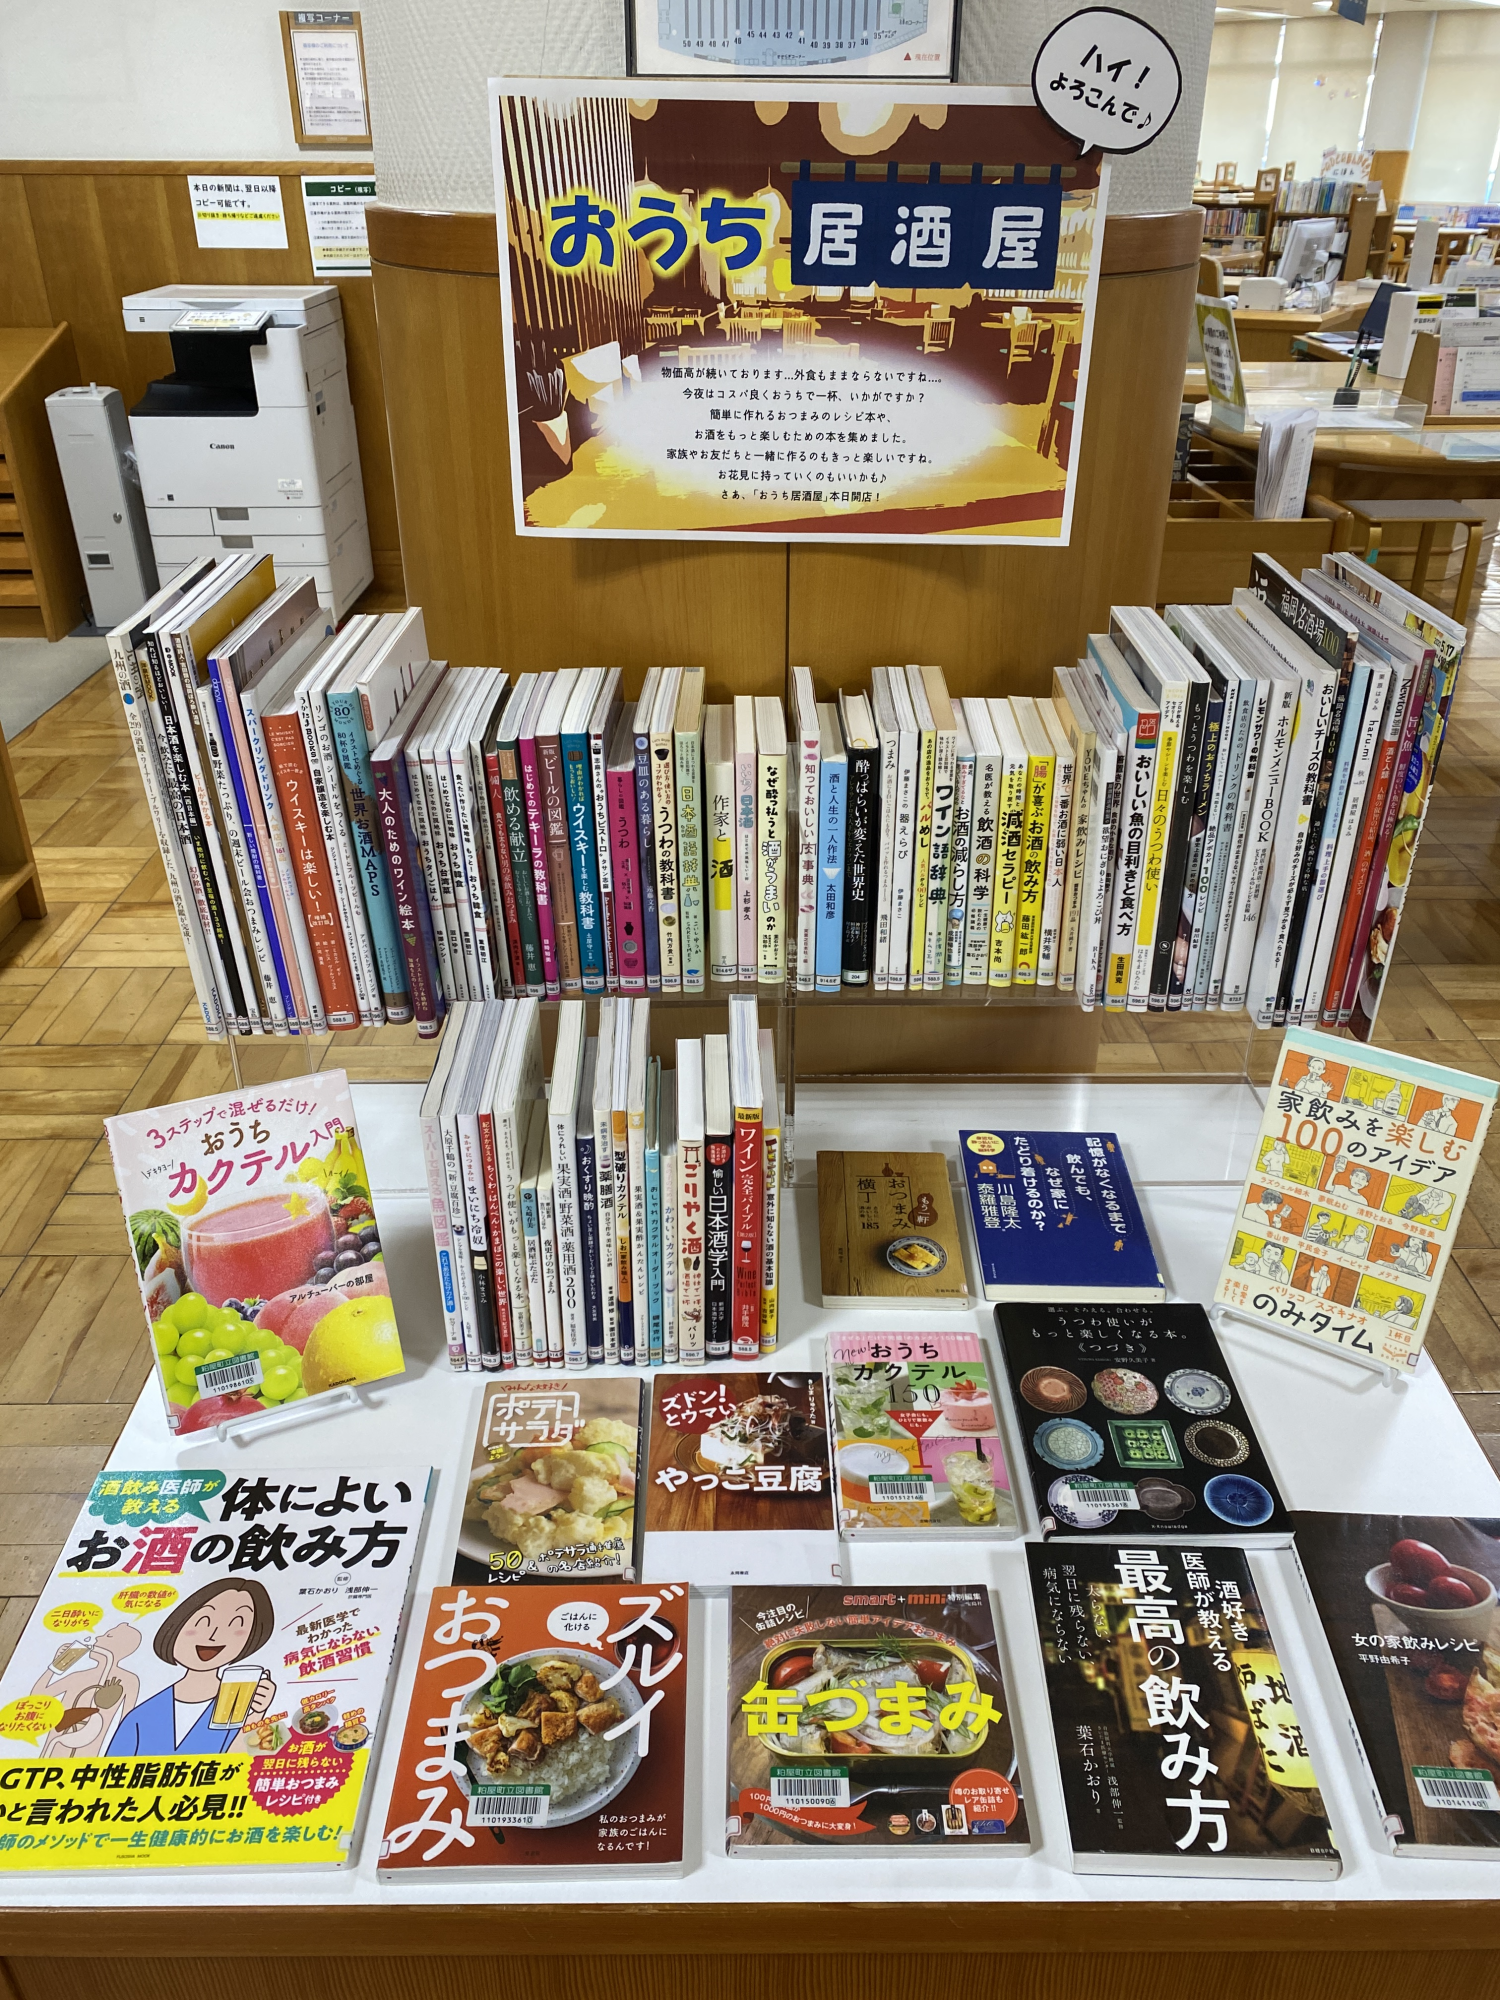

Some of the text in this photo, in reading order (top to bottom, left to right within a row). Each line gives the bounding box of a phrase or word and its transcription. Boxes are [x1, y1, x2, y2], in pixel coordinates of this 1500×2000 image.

[298, 13, 349, 23] 複写コーナー
[683, 40, 729, 48] 50 49 48 47
[734, 37, 742, 45] 46
[747, 30, 793, 39] 45 44 43 42
[823, 41, 831, 49] 39
[835, 41, 843, 49] 38
[861, 38, 868, 46] 36
[914, 53, 940, 61] 現在位置
[1080, 44, 1150, 89] ハイ！
[194, 183, 276, 193] 本日の新聞は、翌日以降
[196, 200, 251, 208] コピー可能です。
[549, 194, 1045, 271] おうち 居酒屋
[682, 388, 924, 403] 今夜はコスパ良くおうちで一杯、いかがですか？
[710, 408, 891, 423] 簡単に作れるおつまみのレシピ本や、
[694, 429, 907, 443] お酒をもっと楽しむための本を集めました。
[666, 448, 933, 464] 家族やお友だちと一緒に作るのもきっと楽しいですね。
[721, 489, 880, 502] さあ、「おうち居酒屋」本日開店！
[1281, 589, 1340, 656] 福岡名酒場100
[113, 648, 133, 691] 九州の酒
[884, 739, 897, 769] つまみ
[1180, 703, 1201, 804] もっとうつわを楽しむ
[1246, 699, 1265, 779] レモンサワーの教科書
[1302, 683, 1333, 806] おいしいチーズの教科書
[246, 708, 274, 810] スパークリングドリンク
[1197, 721, 1219, 817] 極上のおうちラーメン
[544, 758, 565, 836] ビールの図鑑
[636, 754, 651, 849] 豆皿のある暮らし
[1222, 753, 1243, 833] ドリンクの教科書
[504, 786, 527, 863] 飲める献立
[618, 817, 629, 849] うつわ
[826, 774, 840, 864] 酒と人生の一人作法
[852, 759, 870, 901] 酔っぱらいが変えた世界史
[919, 802, 932, 848] バルめし
[1022, 761, 1049, 903] 「腸」が喜ぶお酒の飲み方
[285, 779, 323, 913] ウイスキーは楽しい！
[525, 765, 548, 906] はじめてのテキーラの教科書
[711, 795, 734, 879] 作家と酒
[929, 785, 954, 905] ワイン語辞典
[1117, 754, 1151, 936] おいしい魚の目利きと食べ方
[1145, 790, 1168, 891] 日々のうつわ使い
[379, 789, 415, 930] 大人のためのワイン絵本
[572, 803, 595, 930] ウイスキーを楽しむ教科書
[658, 807, 675, 900] うつわの教科書
[949, 807, 970, 907] お酒の減らし方
[973, 817, 993, 900] 飲酒の科学
[1001, 811, 1023, 905] 減酒セラピー
[825, 884, 836, 920] 太田和彦
[201, 1120, 271, 1155] おうち
[1277, 1091, 1468, 1162] 家飲みを楽しむ
[1278, 1113, 1457, 1184] 100のアイデア
[582, 1156, 594, 1210] おくすり晩酌
[600, 1171, 614, 1208] 薬膳酒
[740, 1128, 759, 1230] ワイン完全バイブル
[857, 1178, 877, 1204] 横丁
[1014, 1136, 1046, 1231] たどり着けるのか？
[1046, 1167, 1069, 1210] なぜ家に
[1066, 1153, 1094, 1203] 飲んでも、
[1086, 1137, 1127, 1233] 記憶がなくなるまで
[467, 1186, 484, 1245] まいにち冷奴
[682, 1163, 702, 1254] ごりやく酒
[888, 1178, 912, 1230] おつまみ
[997, 1183, 1021, 1229] 川島隆太
[1356, 1208, 1393, 1226] 清野とおる
[707, 1168, 729, 1291] 愉しい日本酒学入門
[289, 1273, 374, 1303] アルチューバーの部屋
[1032, 1329, 1188, 1339] もっと楽しくなる本。
[1057, 1316, 1152, 1327] うつわ使いが
[1253, 1293, 1374, 1354] のみタイム
[871, 1343, 939, 1359] おうち
[854, 1364, 966, 1382] カクテル
[496, 1398, 575, 1420] ポテト
[662, 1384, 727, 1412] ズドン！
[886, 1384, 941, 1403] 150
[665, 1400, 736, 1428] とウマい
[493, 1420, 586, 1442] サラダ
[99, 1480, 219, 1495] 酒飲み医師が
[655, 1465, 822, 1493] やっこ豆腐
[122, 1498, 179, 1514] 教える
[220, 1476, 412, 1522] 体によい
[66, 1522, 408, 1574] お酒の飲み方
[489, 1550, 523, 1570] 50
[548, 1553, 621, 1574] の名店紹介！
[487, 1571, 525, 1584] レシピ
[118, 1588, 177, 1601] 肝臓の数値が
[124, 1597, 162, 1608] 気になる
[843, 1594, 946, 1606] smart mini
[1214, 1579, 1249, 1642] 酒好き
[51, 1609, 99, 1619] 二日酔いに
[52, 1618, 90, 1627] なりがち
[296, 1608, 360, 1636] 最新医学で
[561, 1613, 597, 1621] ごはんに
[564, 1623, 590, 1631] 化ける
[755, 1610, 804, 1631] 缶詰レシピ
[756, 1604, 796, 1621] 今注目の
[1042, 1567, 1072, 1663] 病気にならない
[1180, 1551, 1233, 1672] 医師が教える
[284, 1626, 381, 1666] 病気にならない
[308, 1623, 353, 1643] わかった
[763, 1615, 956, 1649] 絶対に失敗しない簡単アイデアおつまみ
[1352, 1633, 1480, 1652] 女の家飲みレシピ
[298, 1641, 374, 1677] 飲酒習慣
[599, 1585, 685, 1757] ズルイ
[14, 1711, 43, 1720] お腹に
[741, 1680, 1002, 1738] 缶づまみ
[1113, 1548, 1231, 1852] 最高の飲み方
[386, 1589, 510, 1861] おつまみ
[262, 1757, 343, 1770] 翌日に残らない
[288, 1741, 326, 1754] お酒が
[777, 1768, 841, 1776] 粕屋町立図書館
[1076, 1725, 1100, 1805] 葉石かおり
[254, 1777, 339, 1792] 簡単おつまみ
[477, 1786, 544, 1795] 粕屋町立図書館
[955, 1787, 1010, 1795] 噂のお取り寄せ
[266, 1795, 321, 1807] レシピ付き
[759, 1803, 856, 1831] 1000円のおつまみに大変身！
[785, 1797, 836, 1805] 1101500906
[482, 1816, 532, 1824] 1101933610
[598, 1827, 666, 1837] 家族のごはんに
[599, 1813, 666, 1824] 私のおつまみが
[597, 1842, 650, 1851] なるんです！
